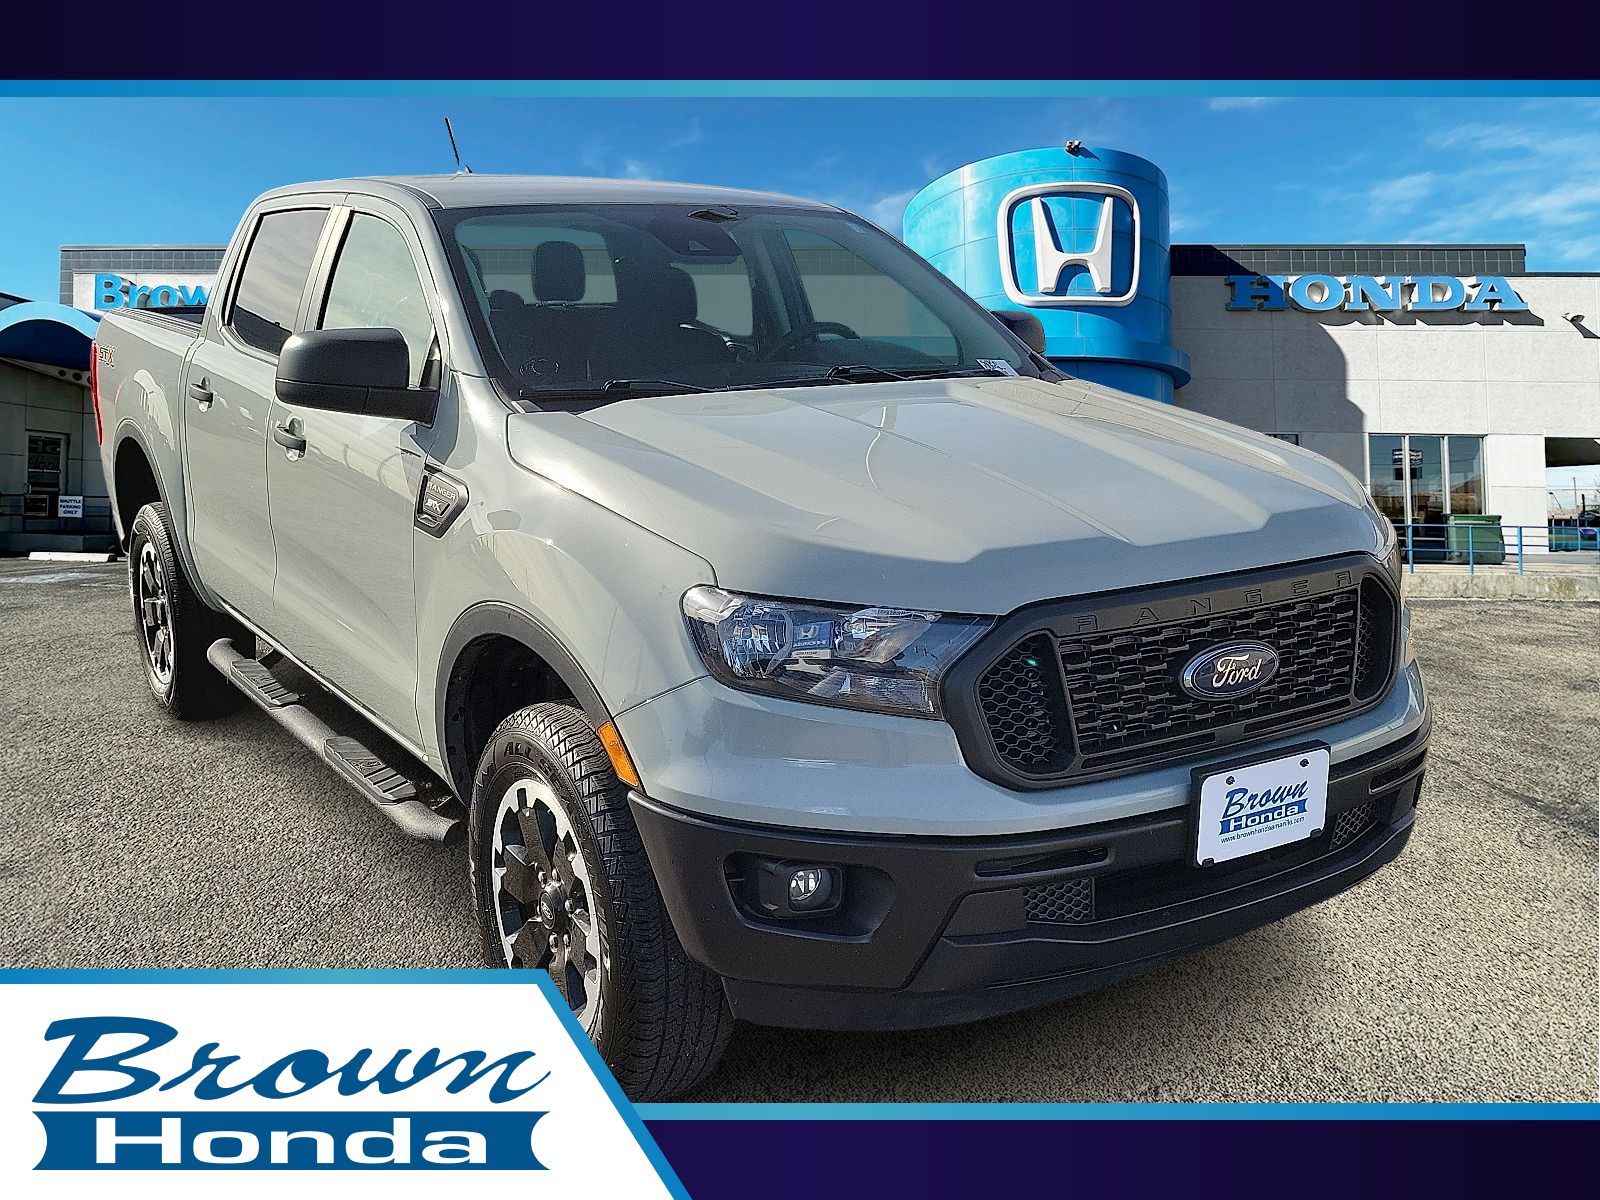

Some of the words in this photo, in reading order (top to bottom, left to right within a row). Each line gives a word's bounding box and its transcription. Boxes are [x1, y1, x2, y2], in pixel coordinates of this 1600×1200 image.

[1225, 274, 1529, 313] HONDA
[427, 481, 457, 501] RANGER
[1073, 571, 1352, 632] RANGER
[1212, 653, 1263, 688] Ford
[1222, 780, 1308, 819] Brown
[1229, 804, 1299, 832] Honda
